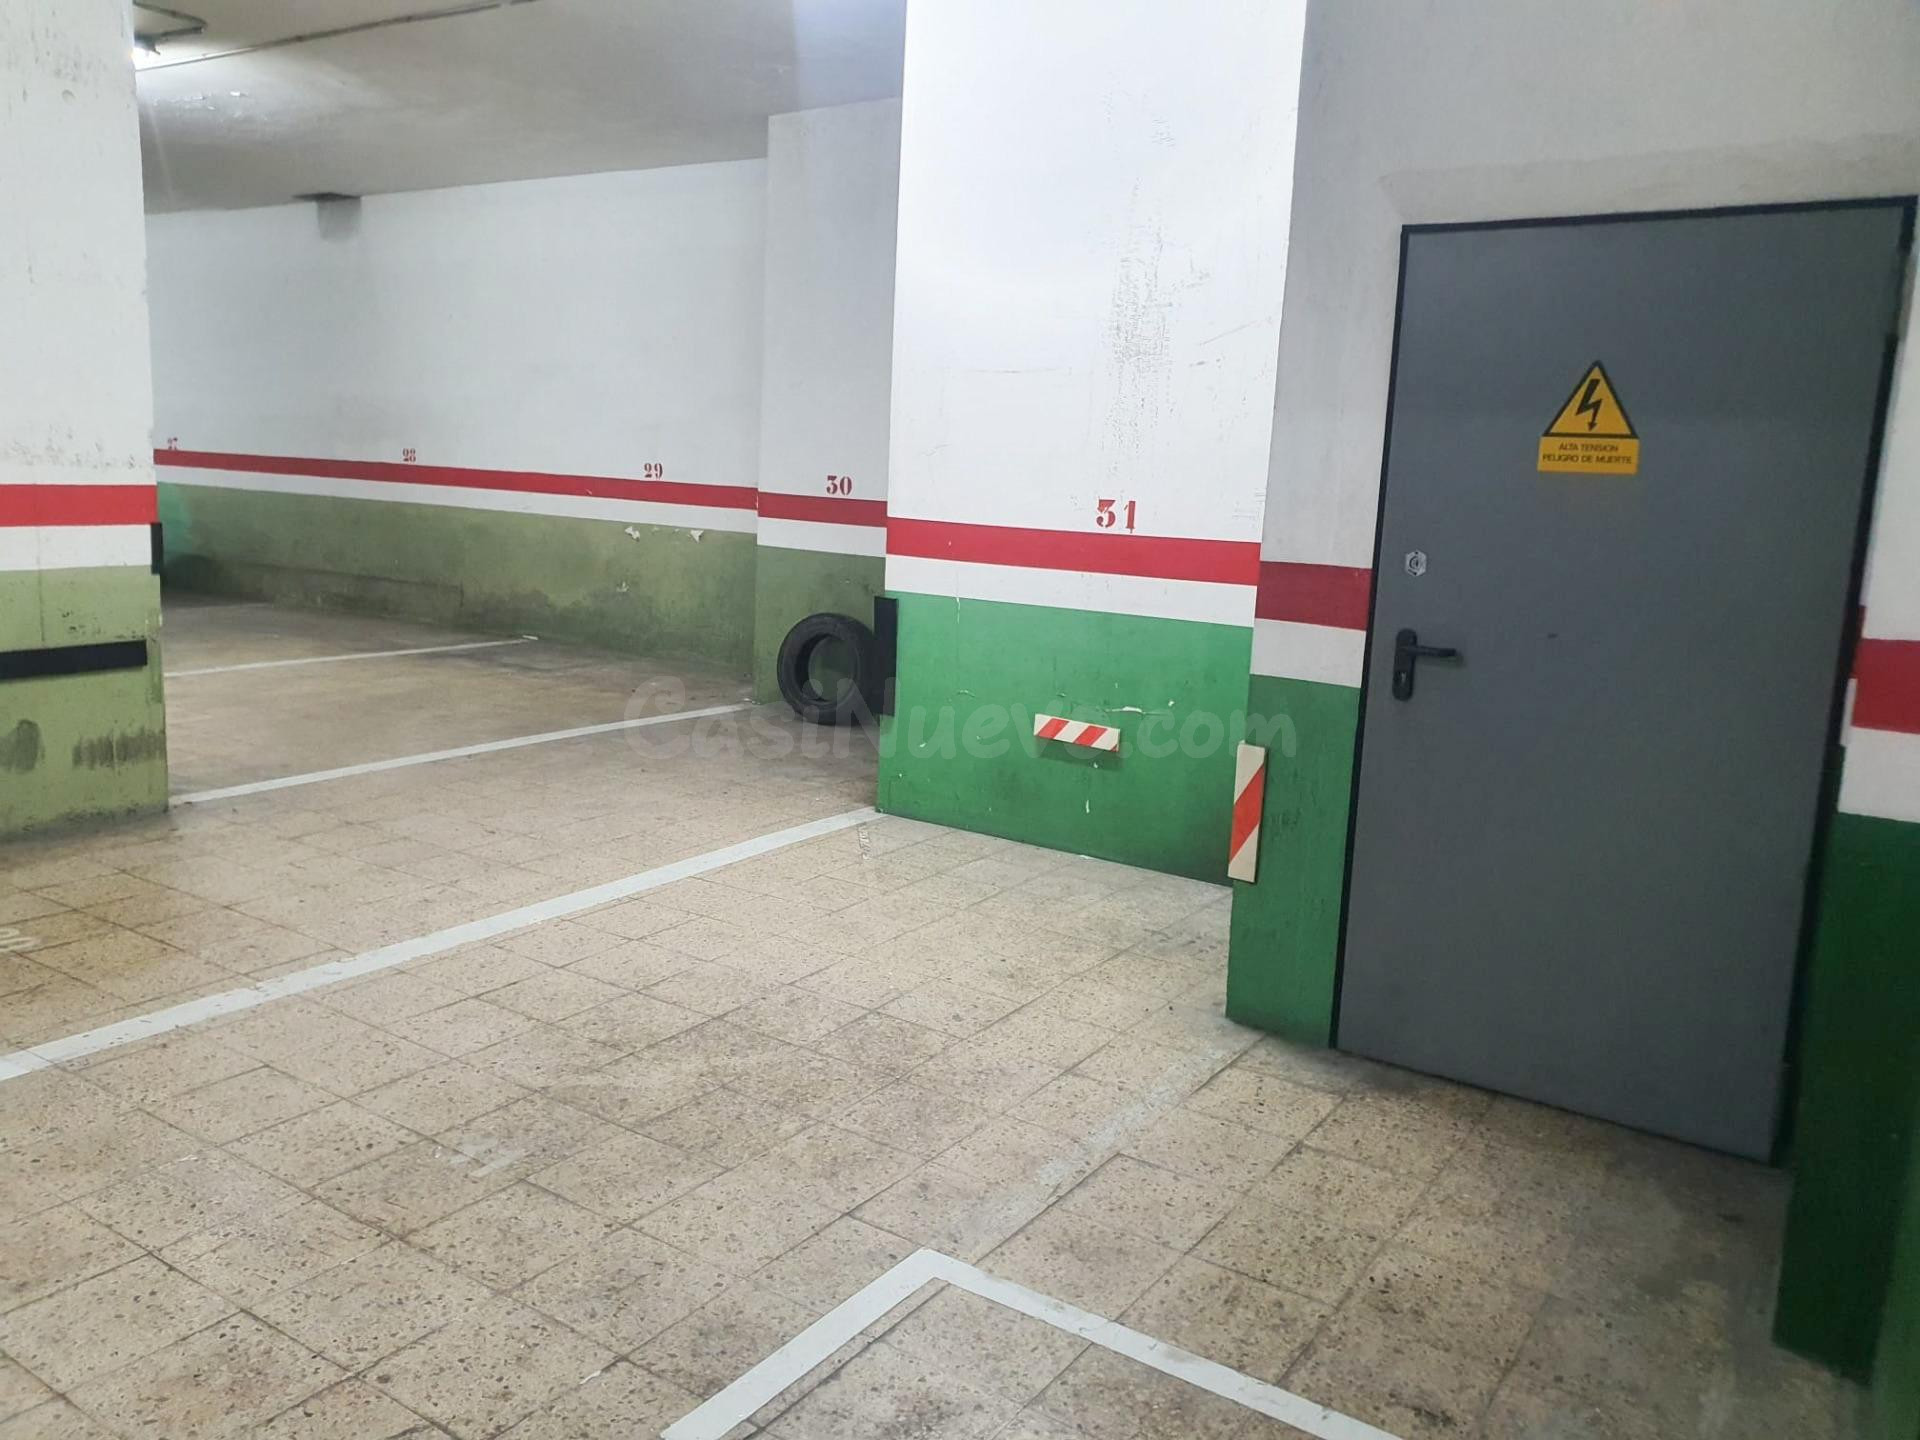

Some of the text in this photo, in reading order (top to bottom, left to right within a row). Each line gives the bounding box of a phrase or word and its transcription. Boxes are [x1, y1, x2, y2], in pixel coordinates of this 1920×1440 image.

[402, 447, 417, 463] 28
[1559, 443, 1579, 451] ALTA
[1542, 453, 1632, 465] PELIGRO DE MUERTE
[644, 462, 663, 480] 29
[826, 475, 853, 496] 30
[1096, 498, 1136, 534] 31
